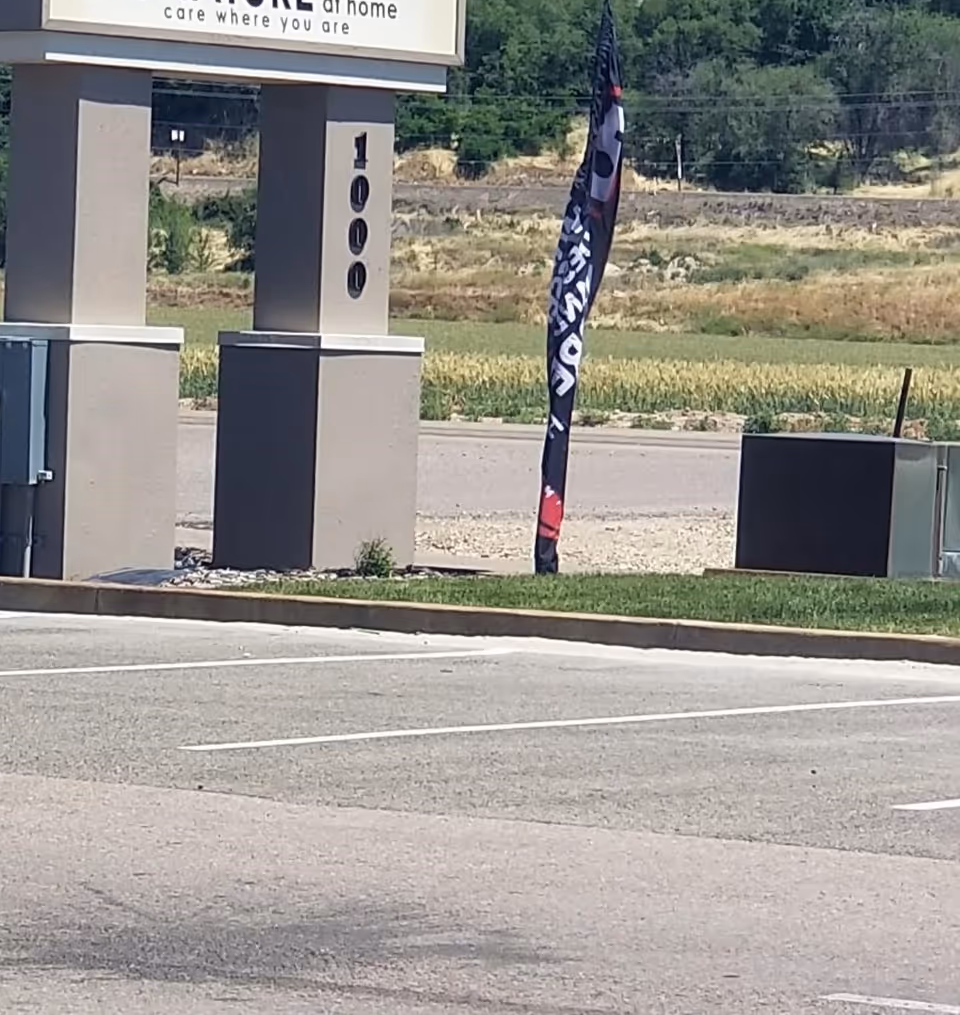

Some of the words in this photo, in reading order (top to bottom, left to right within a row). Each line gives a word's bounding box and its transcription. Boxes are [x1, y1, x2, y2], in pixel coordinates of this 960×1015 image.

[164, 5, 205, 22] care
[216, 8, 270, 28] where
[280, 16, 312, 33] you
[322, 20, 350, 35] are
[347, 132, 370, 300] 1000
